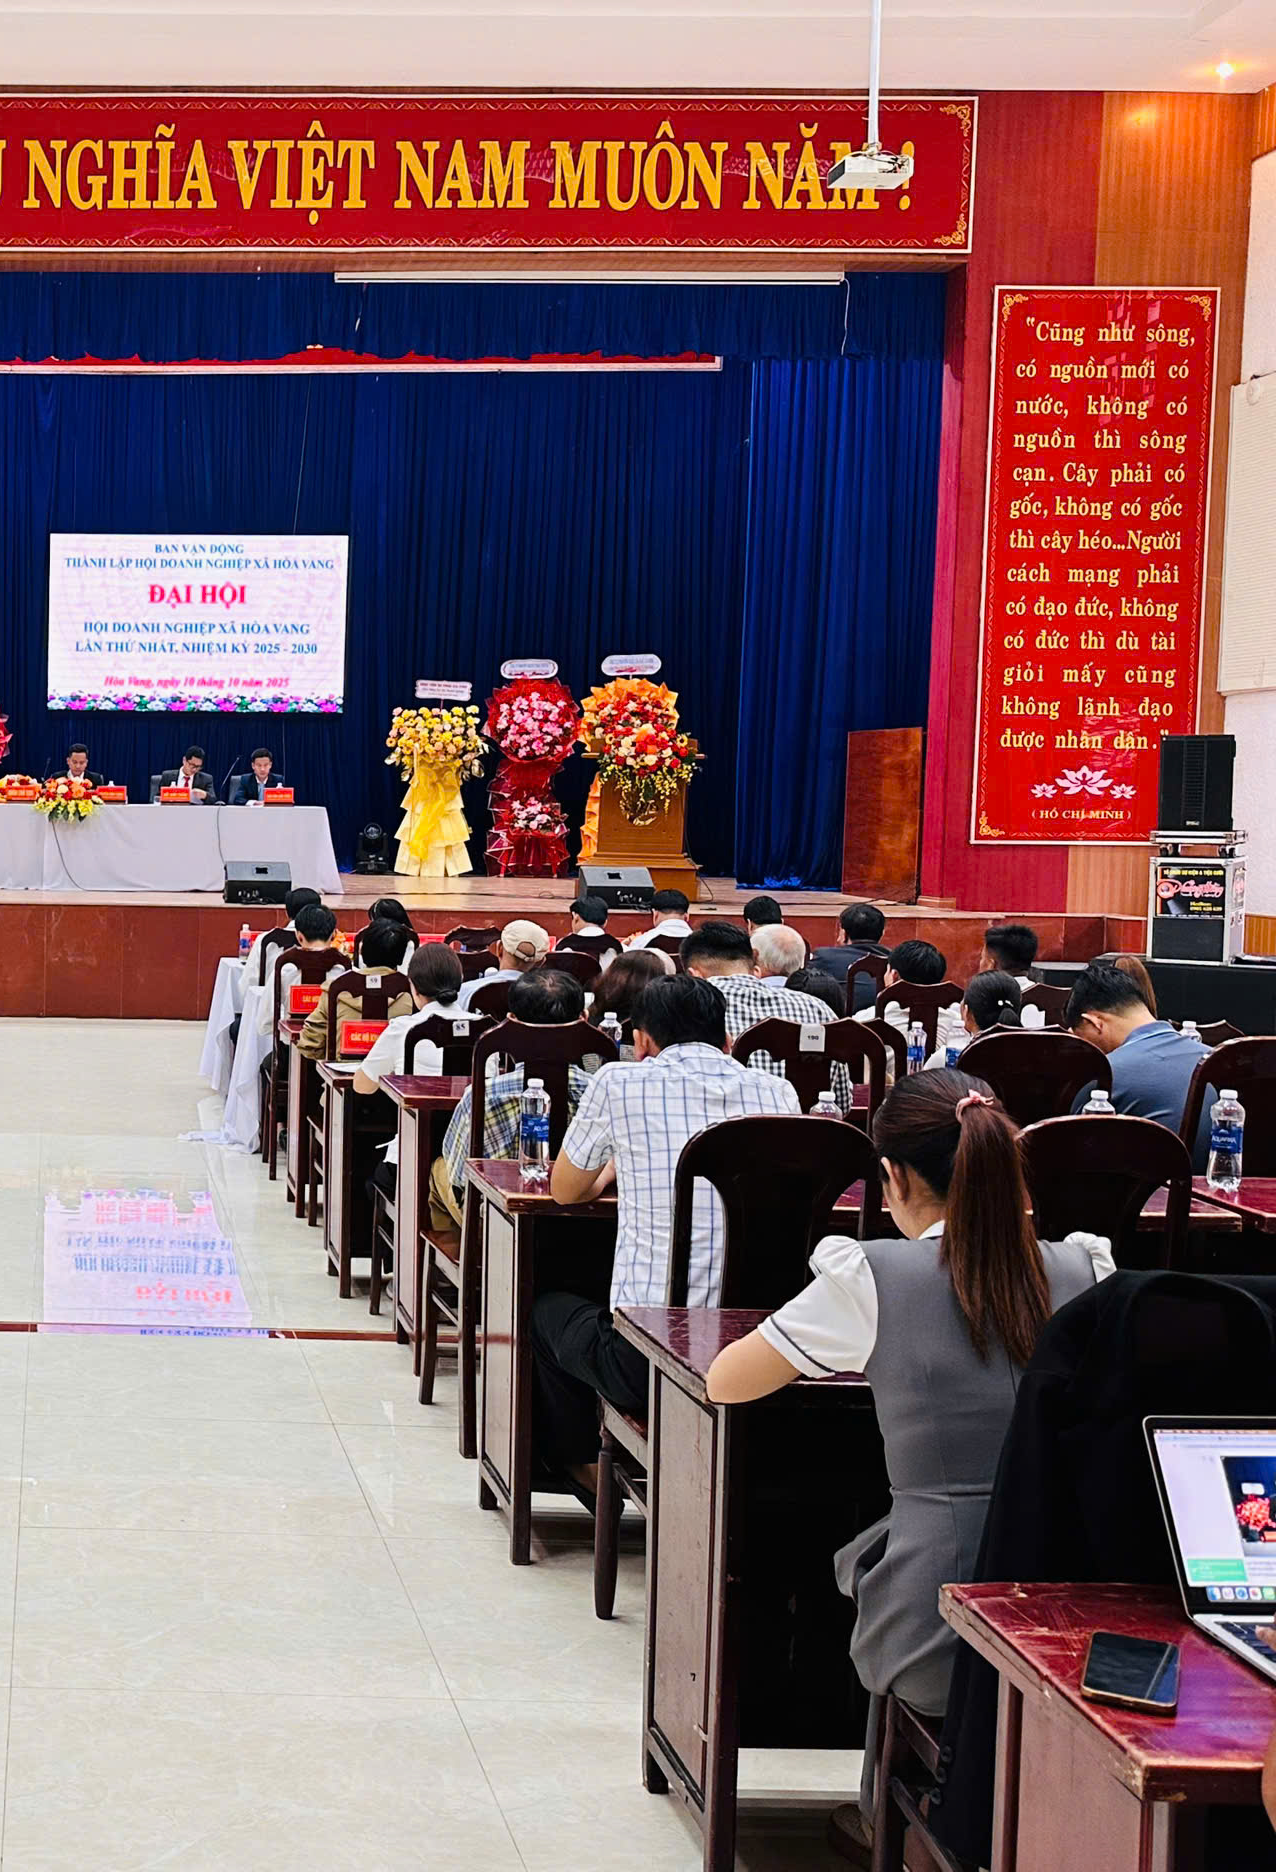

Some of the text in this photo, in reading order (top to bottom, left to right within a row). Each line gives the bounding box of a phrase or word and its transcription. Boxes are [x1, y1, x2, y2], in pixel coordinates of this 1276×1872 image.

[22, 124, 217, 211] NGHĨA
[227, 120, 375, 225] VIỆT
[393, 139, 531, 209] NAM
[548, 120, 728, 212] MUÔN
[1026, 316, 1195, 348] “Cũng như sông,
[1015, 359, 1189, 384] có nguồn mới có
[1016, 393, 1188, 420] nước, không có
[1013, 428, 1188, 454] nguồn thì sông
[1062, 460, 1186, 488] Cây phải có
[1009, 495, 1183, 521] gốc, không có gốc
[1009, 528, 1073, 553] thì cây
[135, 556, 157, 571] HỘI
[160, 558, 203, 569] DOANH
[301, 558, 334, 569] VANG
[1006, 559, 1179, 588] cách mạng phải
[148, 581, 248, 610] ĐẠI HỘI
[1005, 595, 1179, 622] có đạo đức, không
[84, 619, 311, 637] HỘI DOANH NGHIỆP XÃ HÒA VANG
[1003, 630, 1175, 651] có đức thì dù tài
[181, 640, 227, 656] NHIỆM
[253, 642, 281, 654] 2025
[291, 643, 318, 654] 2030
[228, 676, 240, 687] 10
[266, 677, 290, 688] 2025
[1003, 660, 1177, 689] giỏi mấy cũng
[1002, 695, 1173, 722] không lãnh đạo
[999, 727, 1103, 753] được nhân
[1089, 809, 1124, 819] MINH
